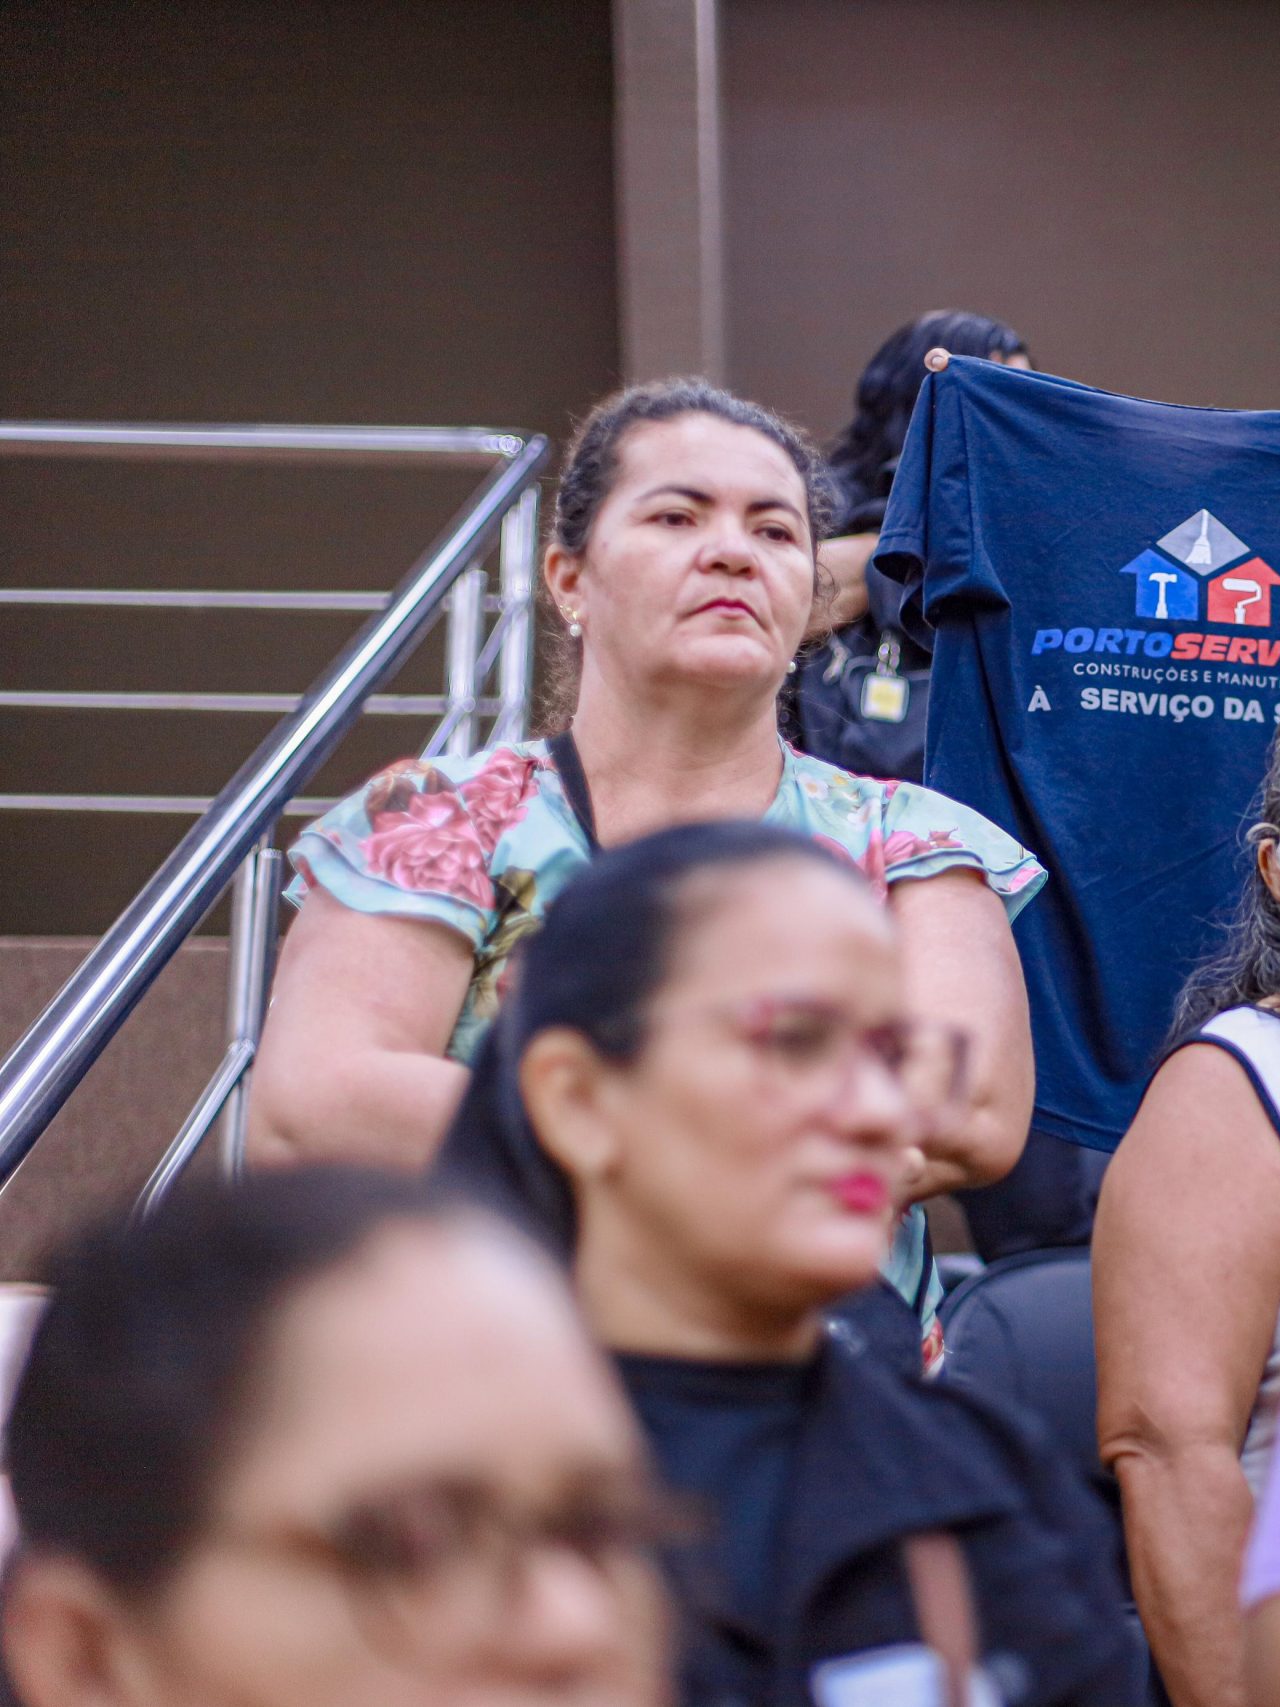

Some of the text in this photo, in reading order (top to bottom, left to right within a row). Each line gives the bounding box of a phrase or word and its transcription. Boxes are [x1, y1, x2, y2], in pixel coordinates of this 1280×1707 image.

[1072, 662, 1199, 684] CONSTRUÇÕES
[1203, 670, 1212, 683] E
[1027, 684, 1051, 712] À
[1080, 687, 1215, 723] SERVIÇO
[1223, 696, 1265, 723] DA
